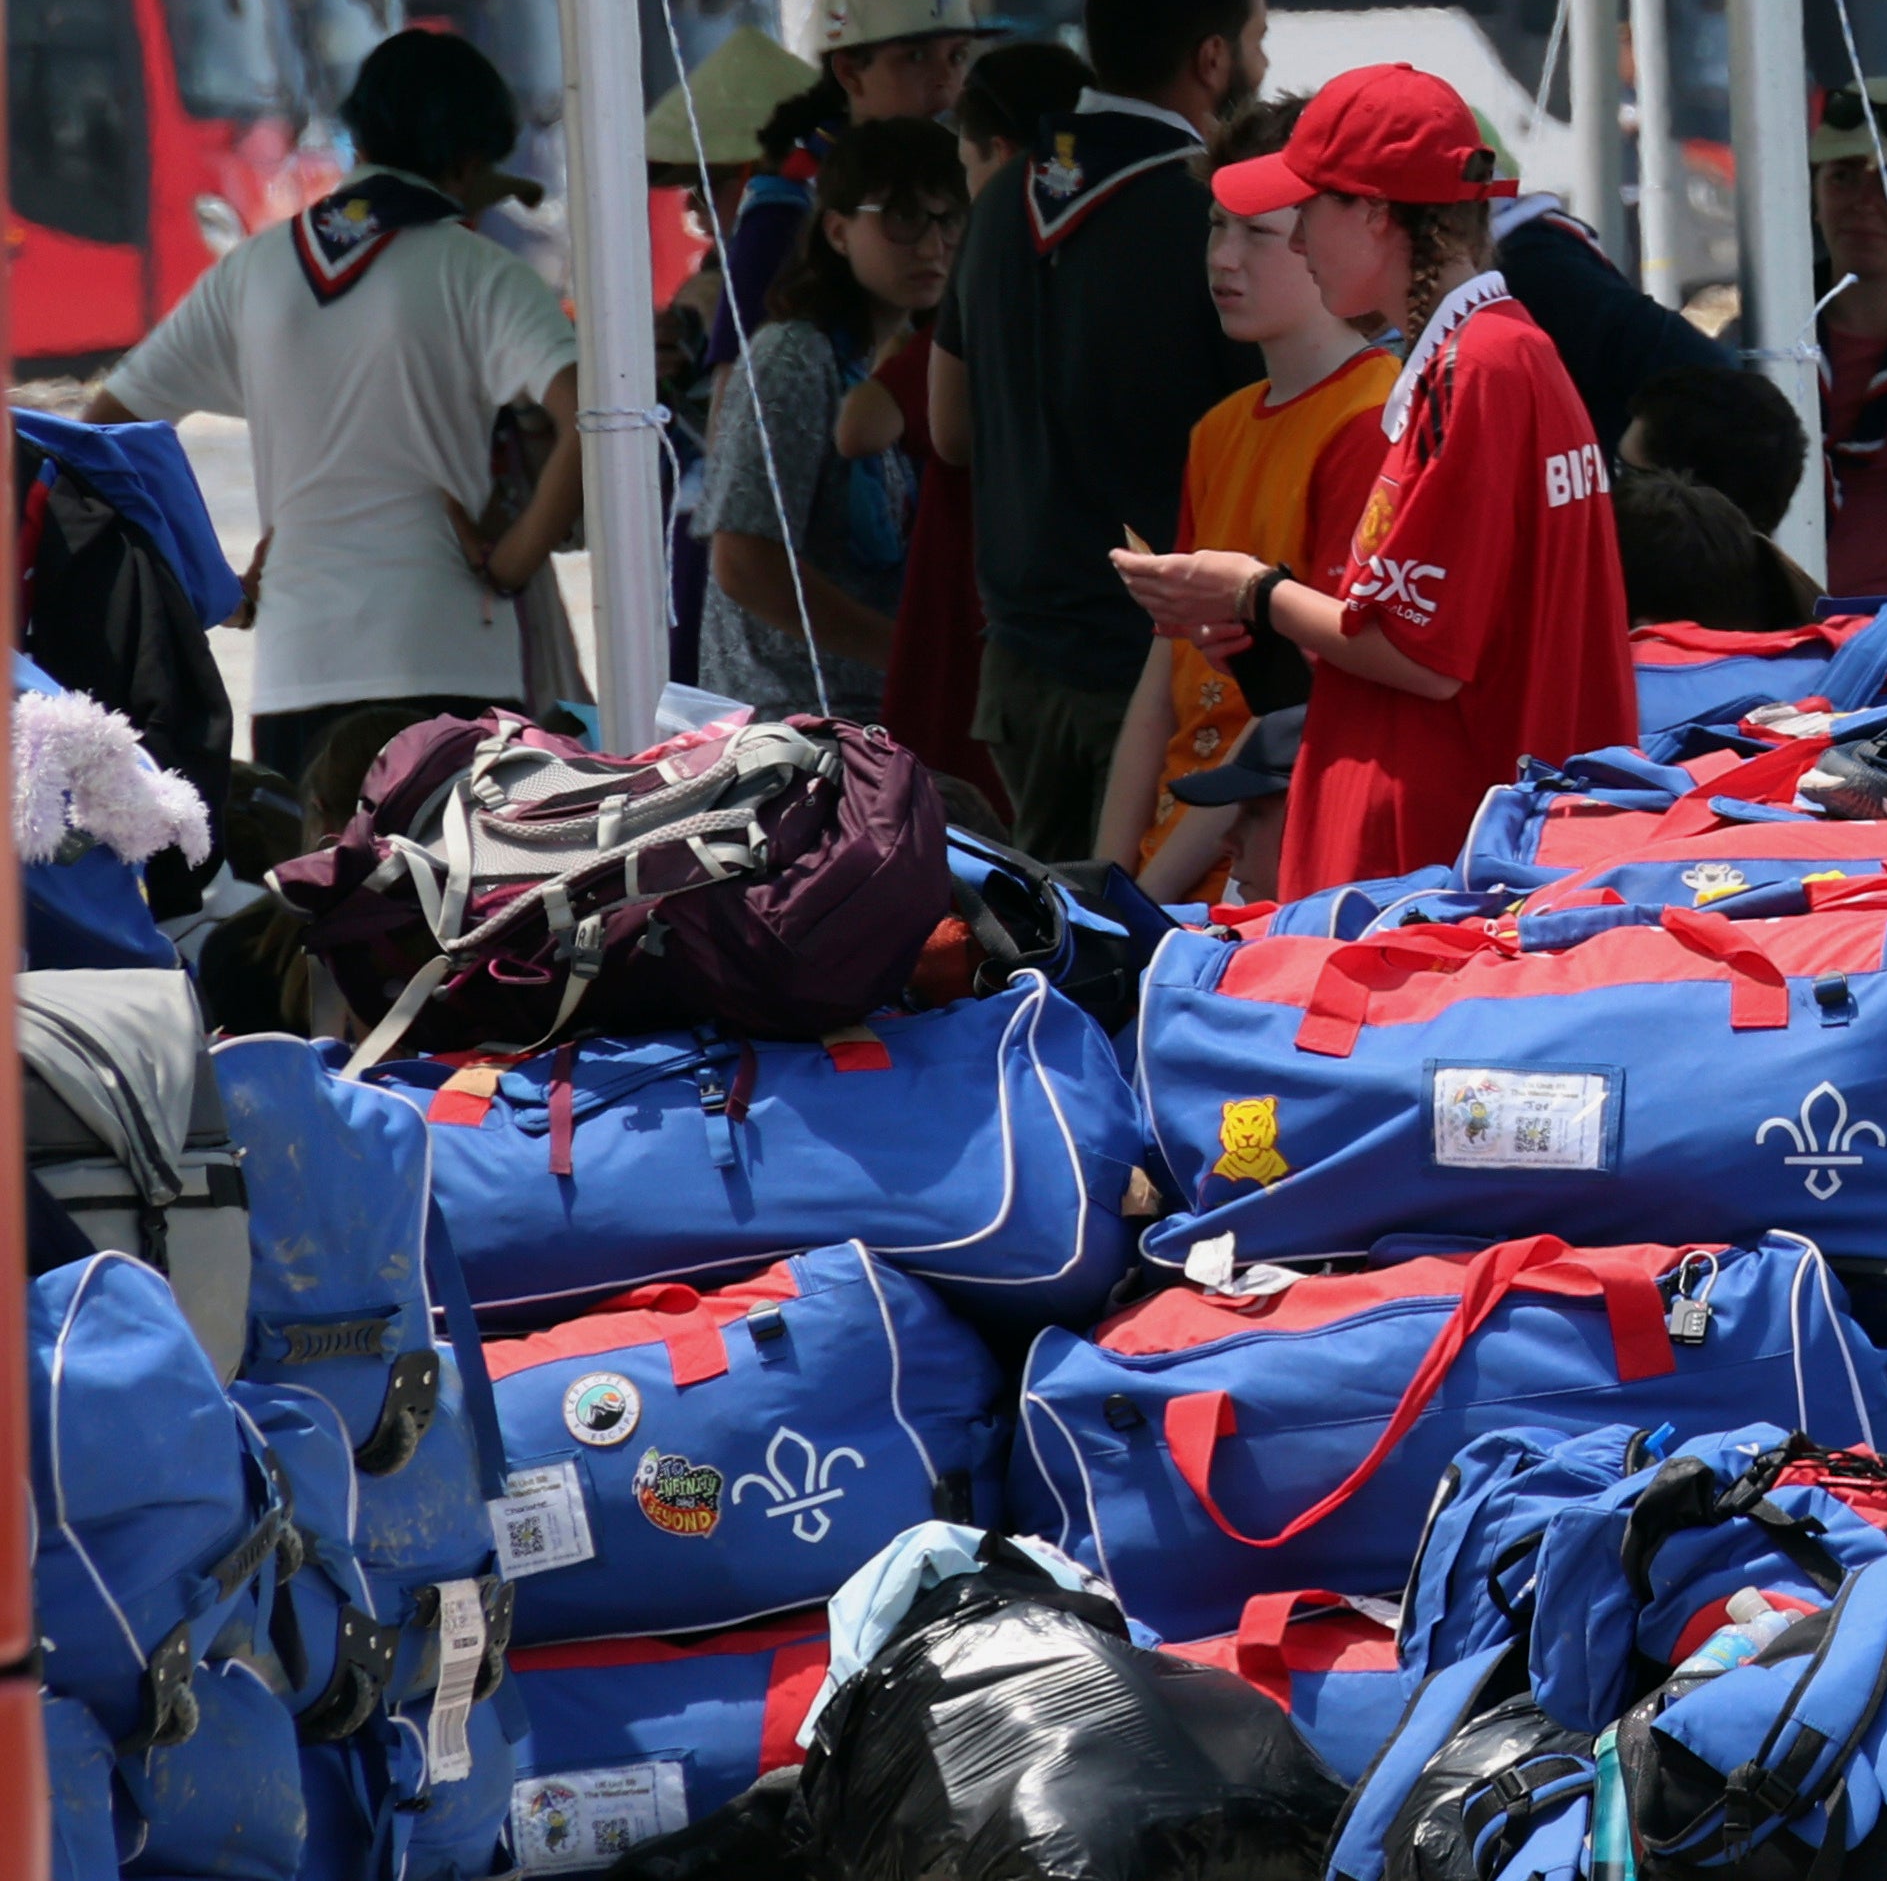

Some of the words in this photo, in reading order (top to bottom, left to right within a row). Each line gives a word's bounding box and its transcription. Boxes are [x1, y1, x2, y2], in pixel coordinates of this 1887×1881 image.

[590, 1409, 636, 1442] ESCAPE
[660, 1460, 685, 1478] TO
[646, 1501, 712, 1532] BEYOND
